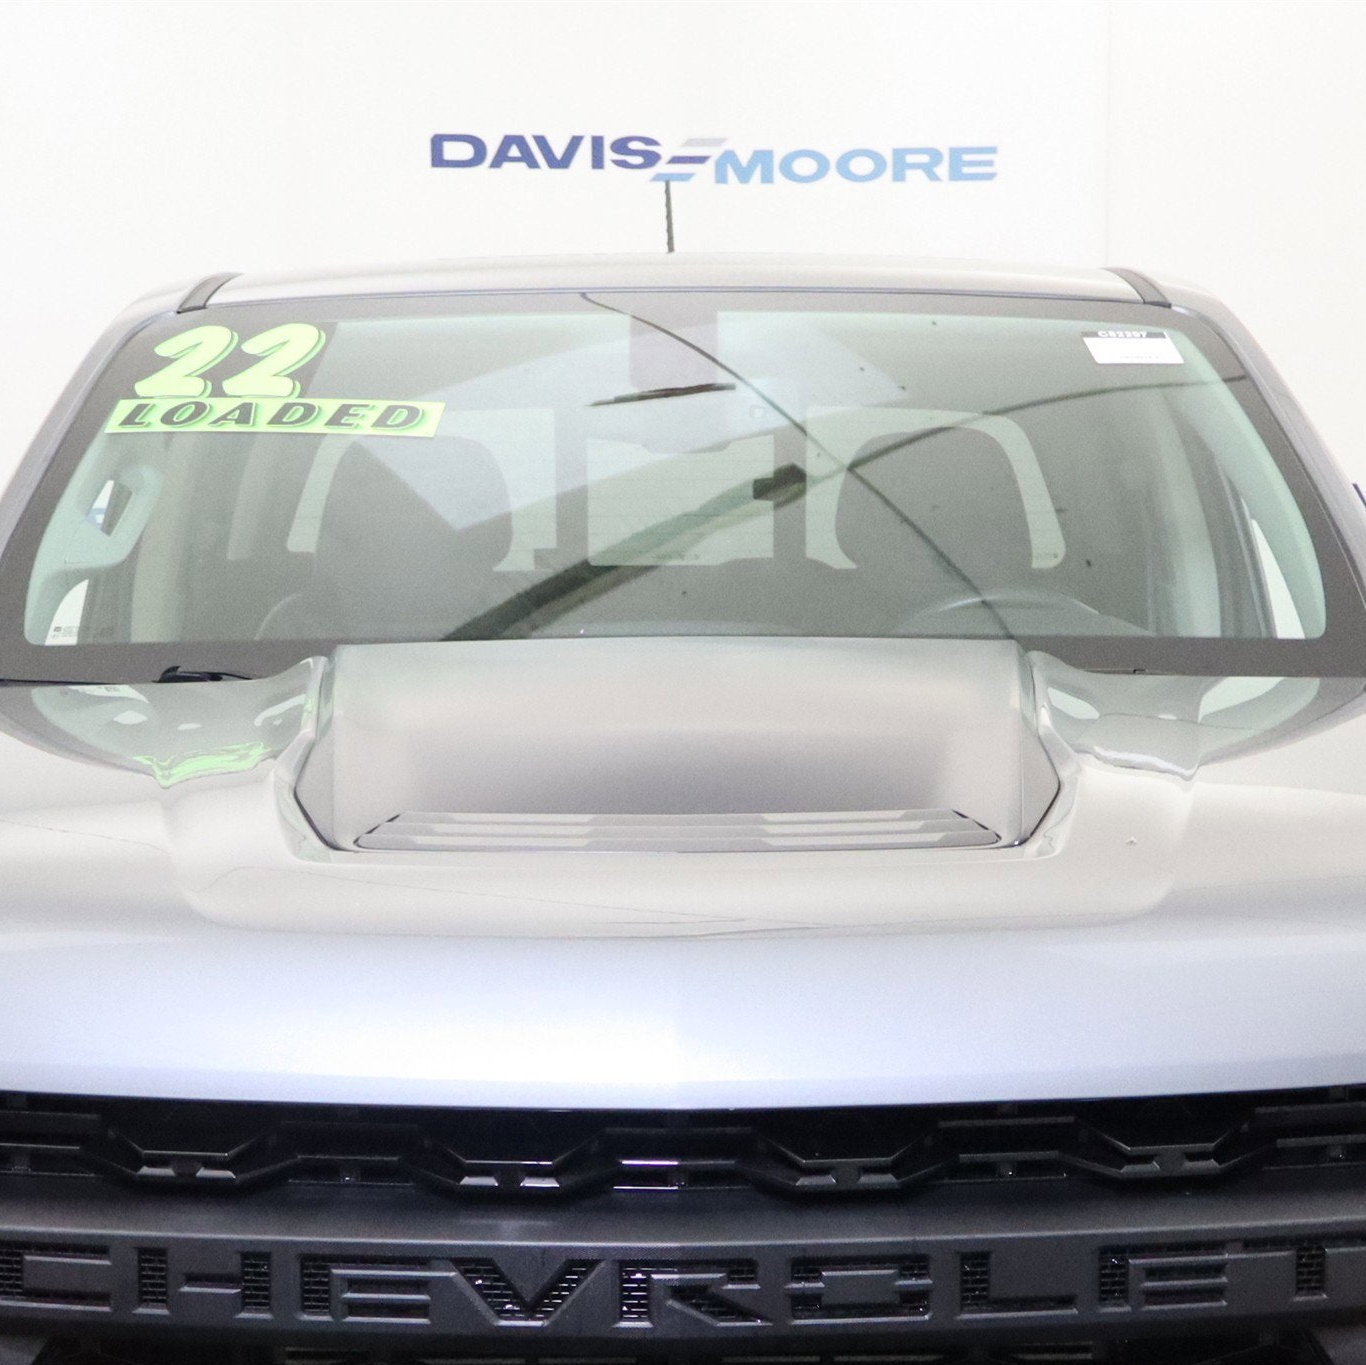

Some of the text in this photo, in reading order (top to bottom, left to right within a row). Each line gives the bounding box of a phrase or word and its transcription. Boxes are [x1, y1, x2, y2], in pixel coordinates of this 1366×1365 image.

[430, 133, 998, 184] DAVIS MOORE
[135, 322, 326, 398] 22
[118, 400, 425, 430] LOADED
